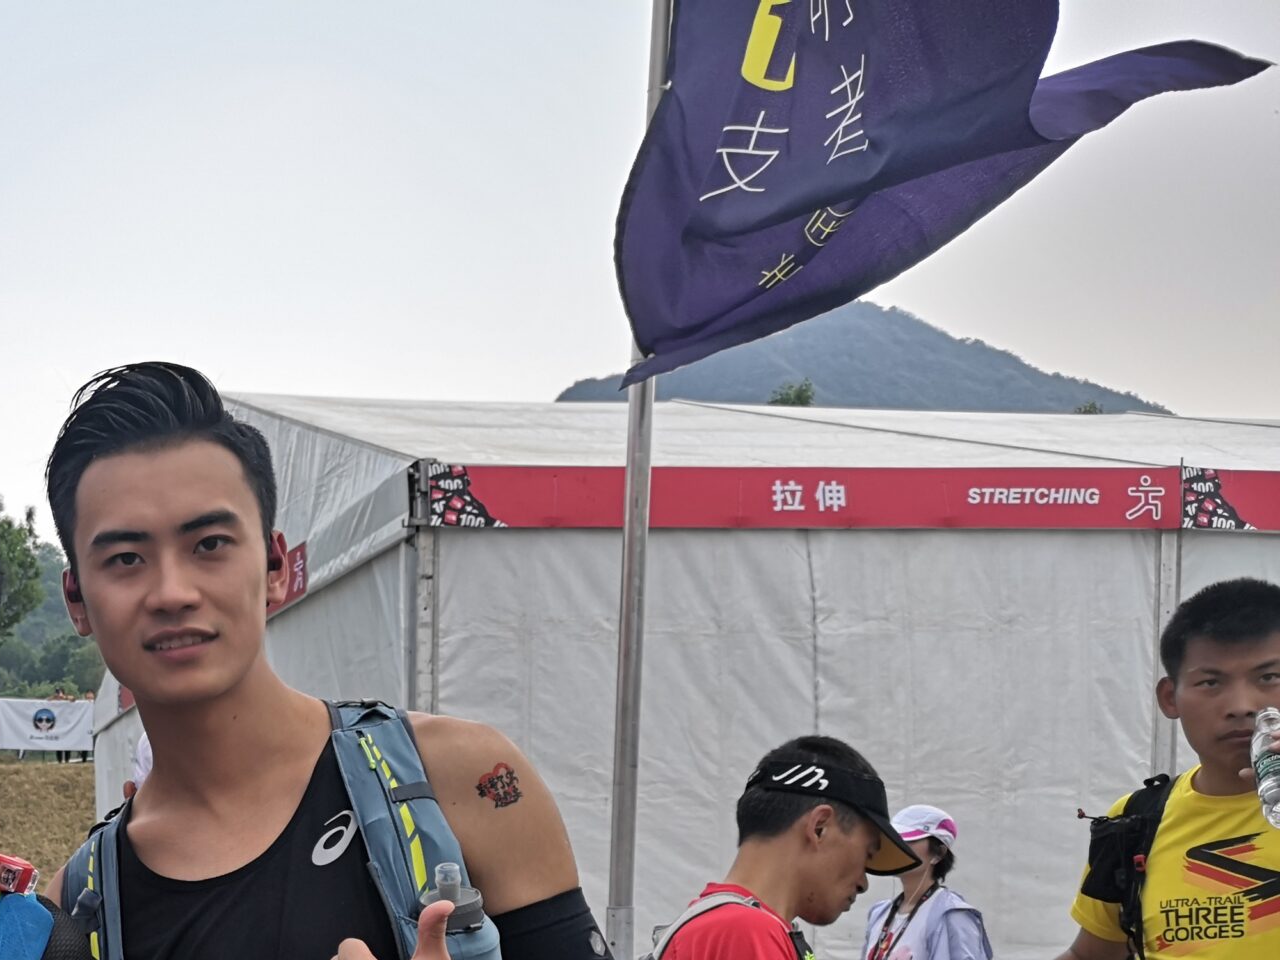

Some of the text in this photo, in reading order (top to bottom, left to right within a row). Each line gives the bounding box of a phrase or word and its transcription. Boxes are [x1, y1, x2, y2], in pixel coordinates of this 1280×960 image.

[698, 111, 789, 201] 支
[772, 480, 847, 513] 拉伸
[966, 487, 1101, 505] STRETCHING
[1160, 906, 1245, 927] THREE
[1162, 924, 1245, 943] GORGES
